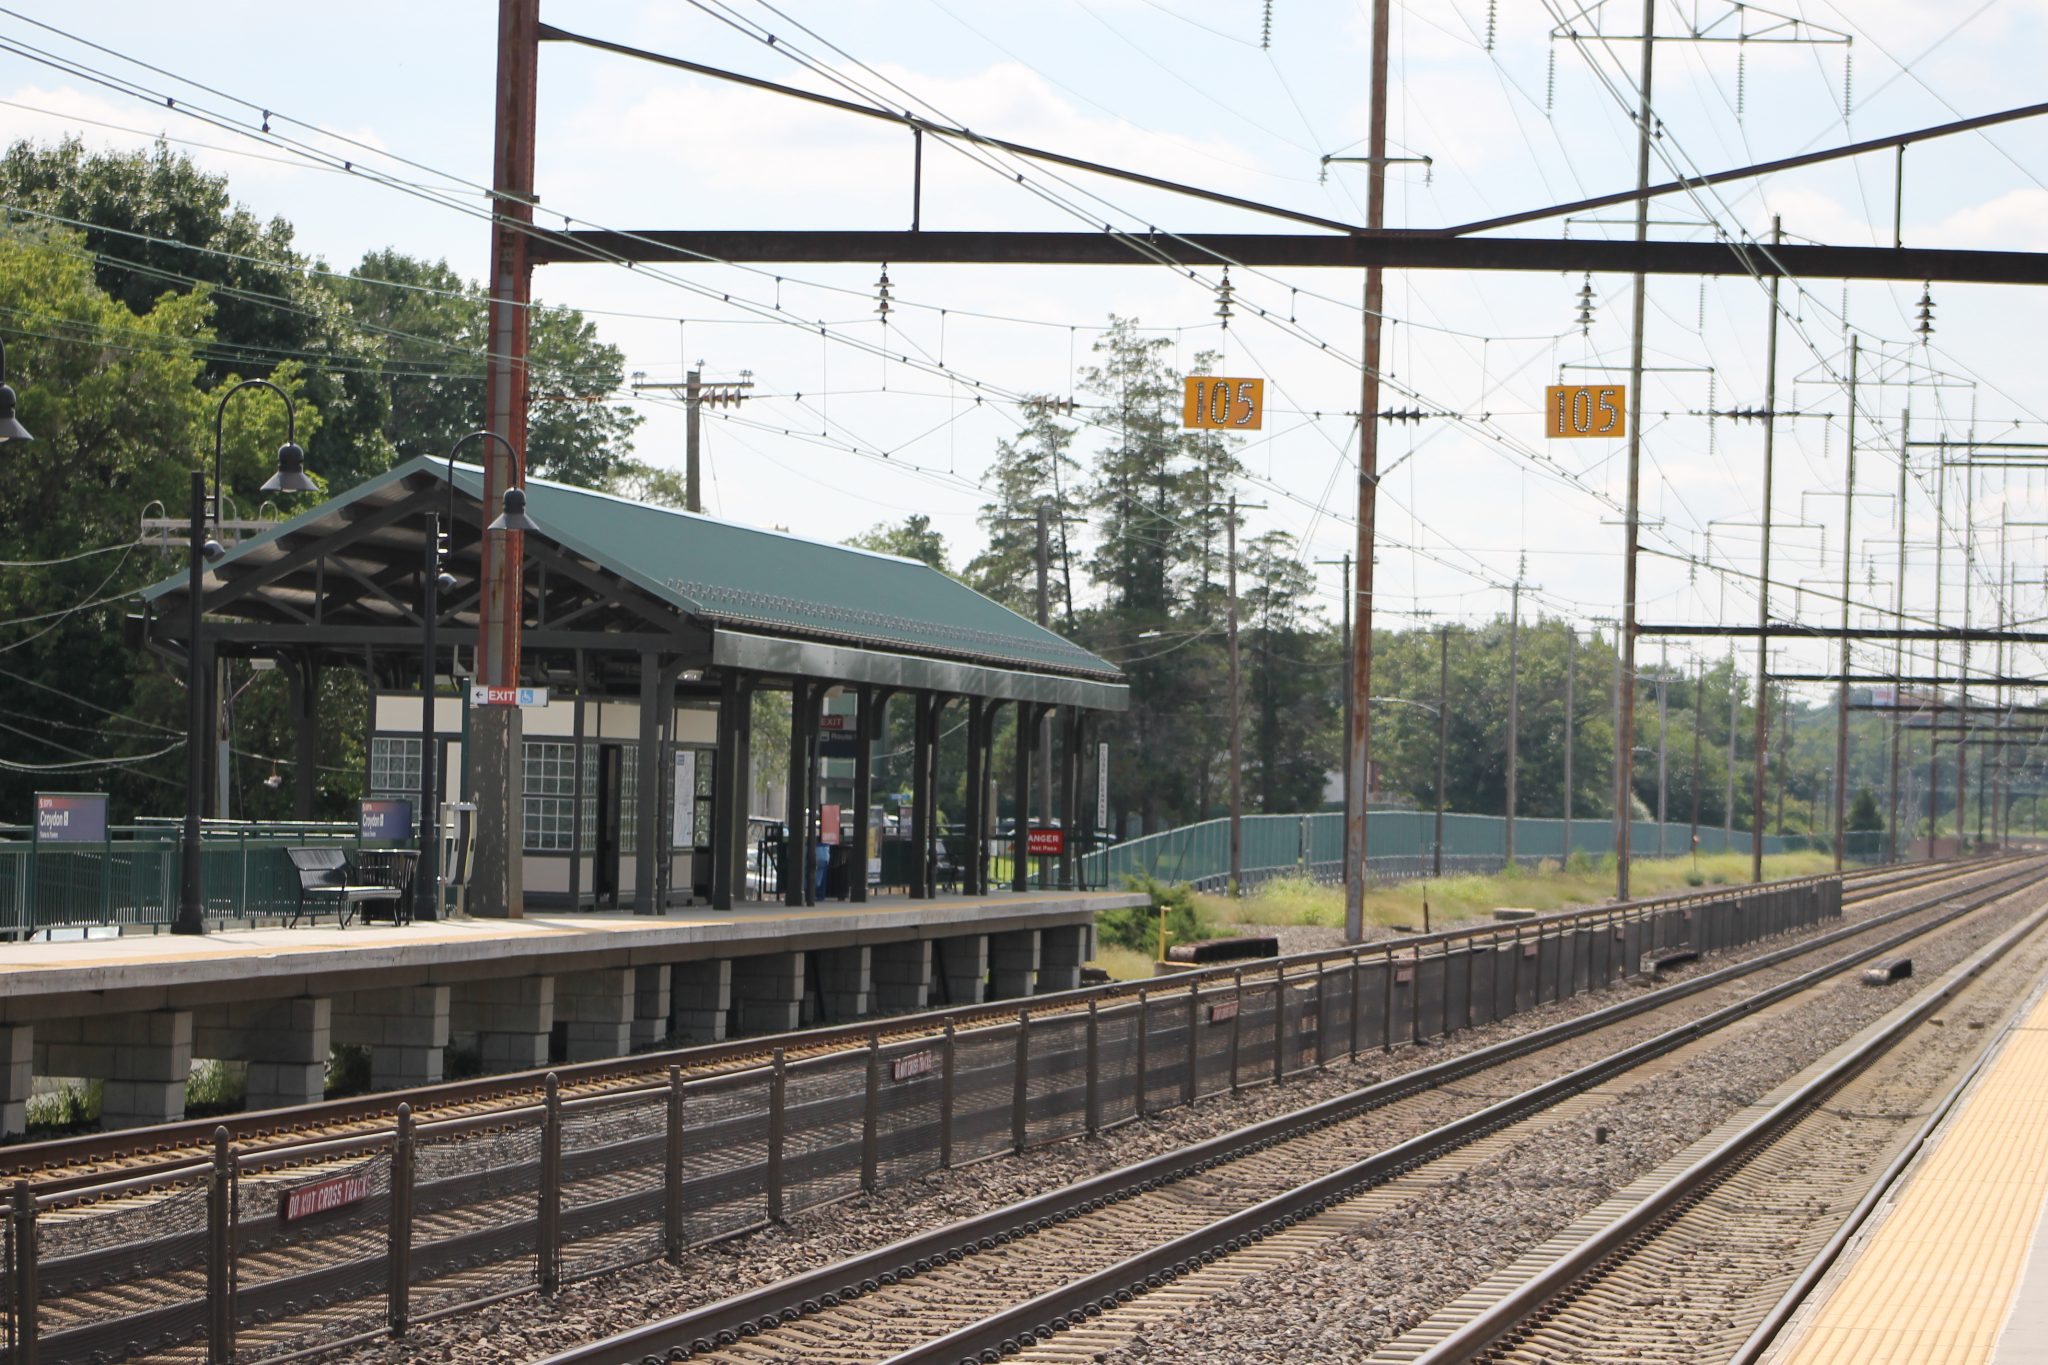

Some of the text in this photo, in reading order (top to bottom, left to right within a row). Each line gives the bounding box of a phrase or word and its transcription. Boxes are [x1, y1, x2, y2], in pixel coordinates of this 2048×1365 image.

[1195, 381, 1254, 424] 105
[1555, 388, 1617, 433] 105
[488, 690, 515, 702] EXIT
[40, 810, 64, 831] Croydon
[1027, 834, 1059, 843] ANGER
[288, 1173, 373, 1220] DO NOT CROSS TRACKS
